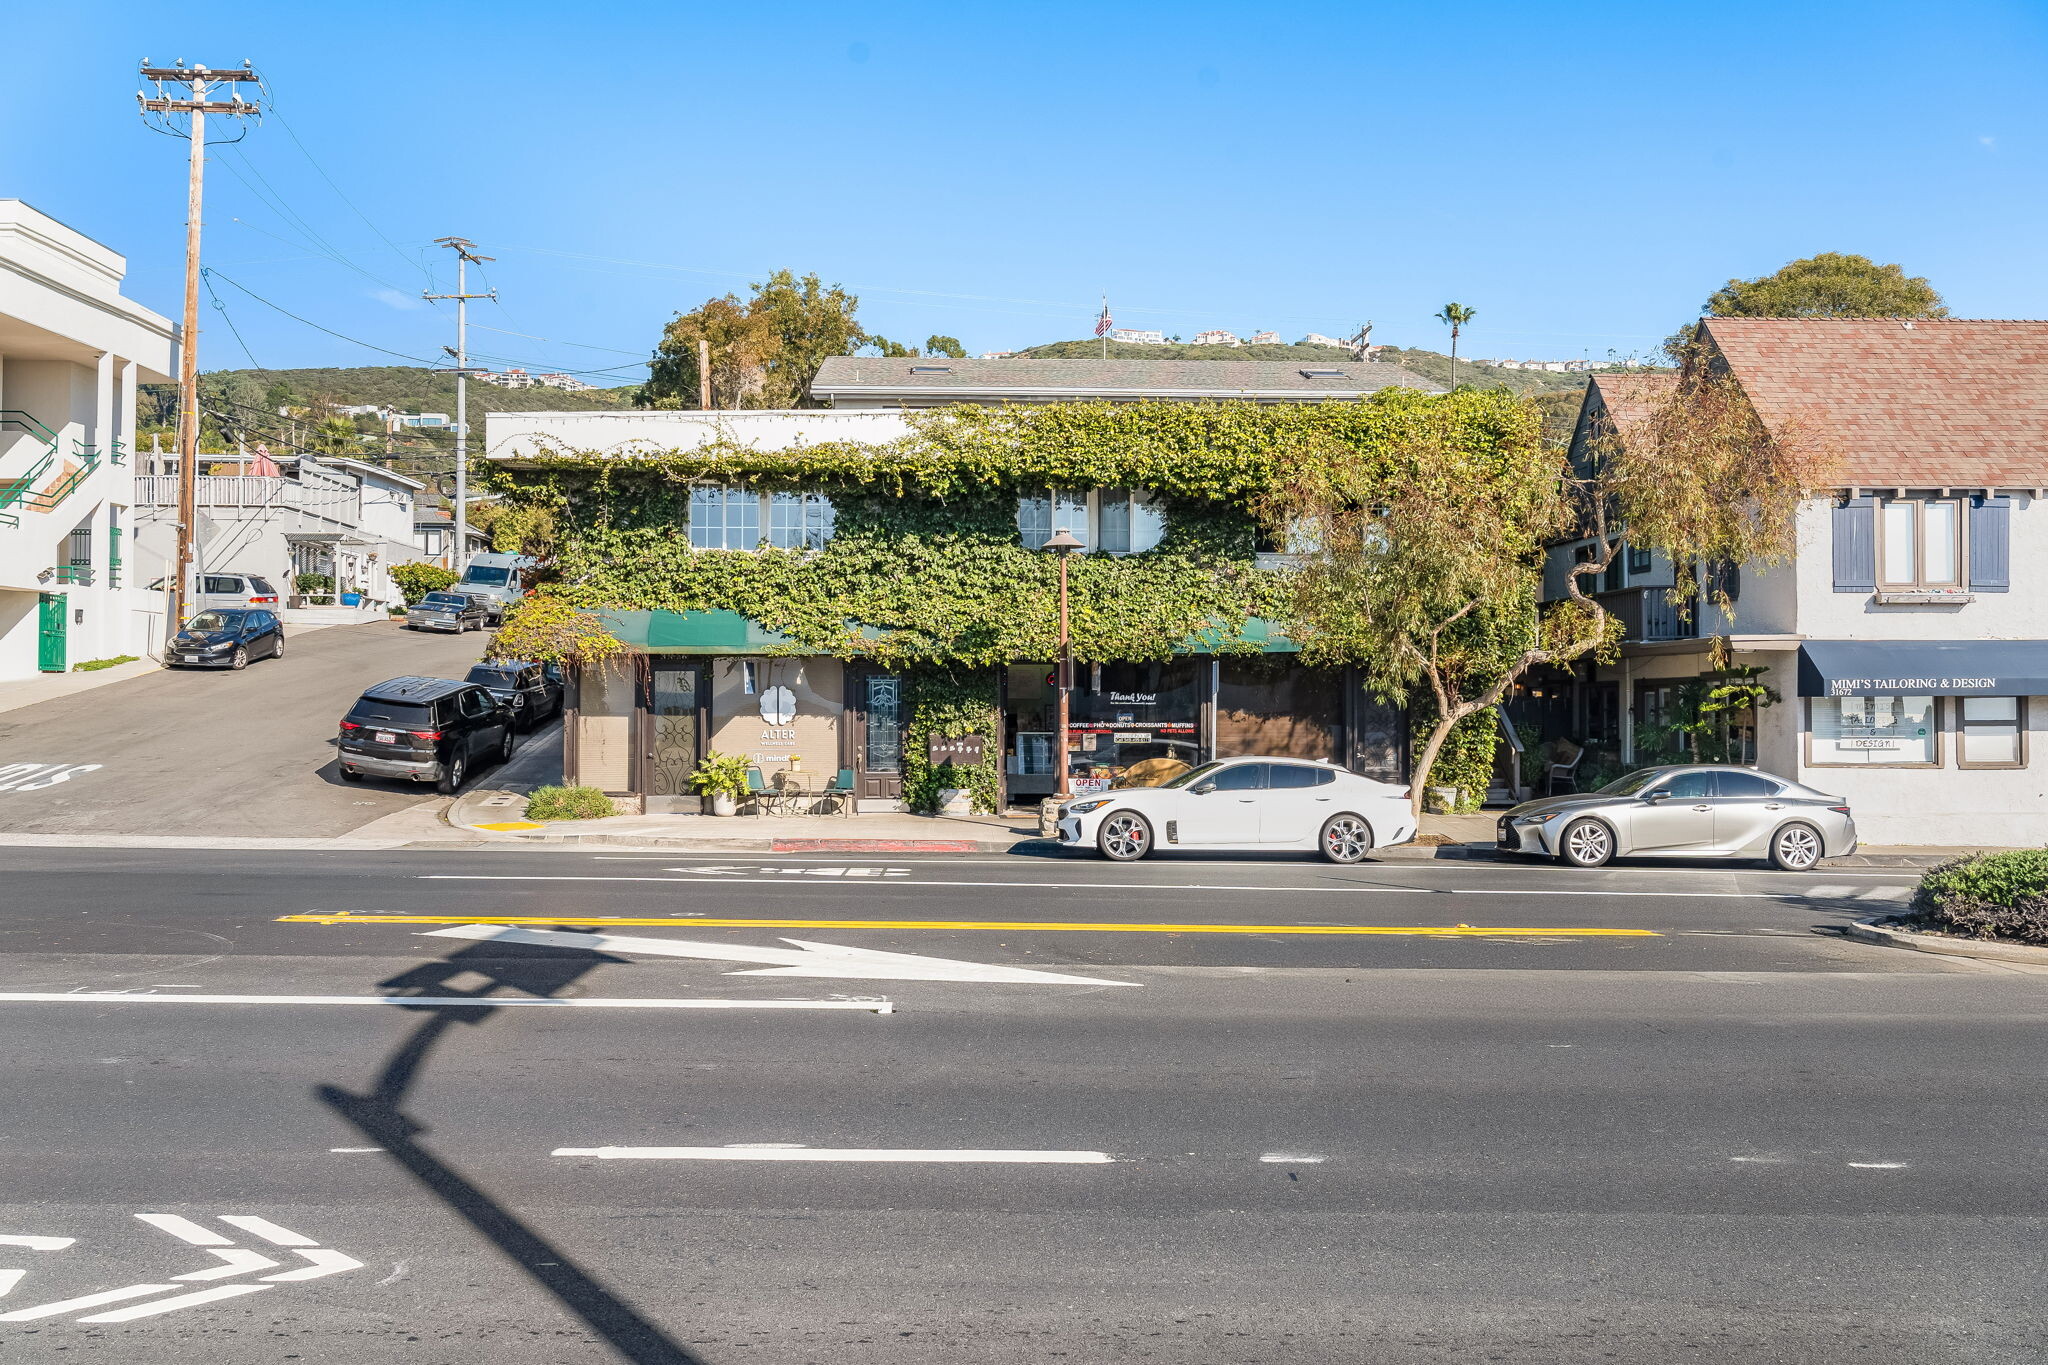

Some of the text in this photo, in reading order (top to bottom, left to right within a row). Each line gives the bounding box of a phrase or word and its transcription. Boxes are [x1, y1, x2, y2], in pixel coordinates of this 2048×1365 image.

[1831, 678, 1996, 689] MIMI'S TAILORING & DESIGN
[1110, 692, 1156, 702] Thank You!
[760, 730, 795, 739] ALTER
[1855, 740, 1890, 748] DESIGN
